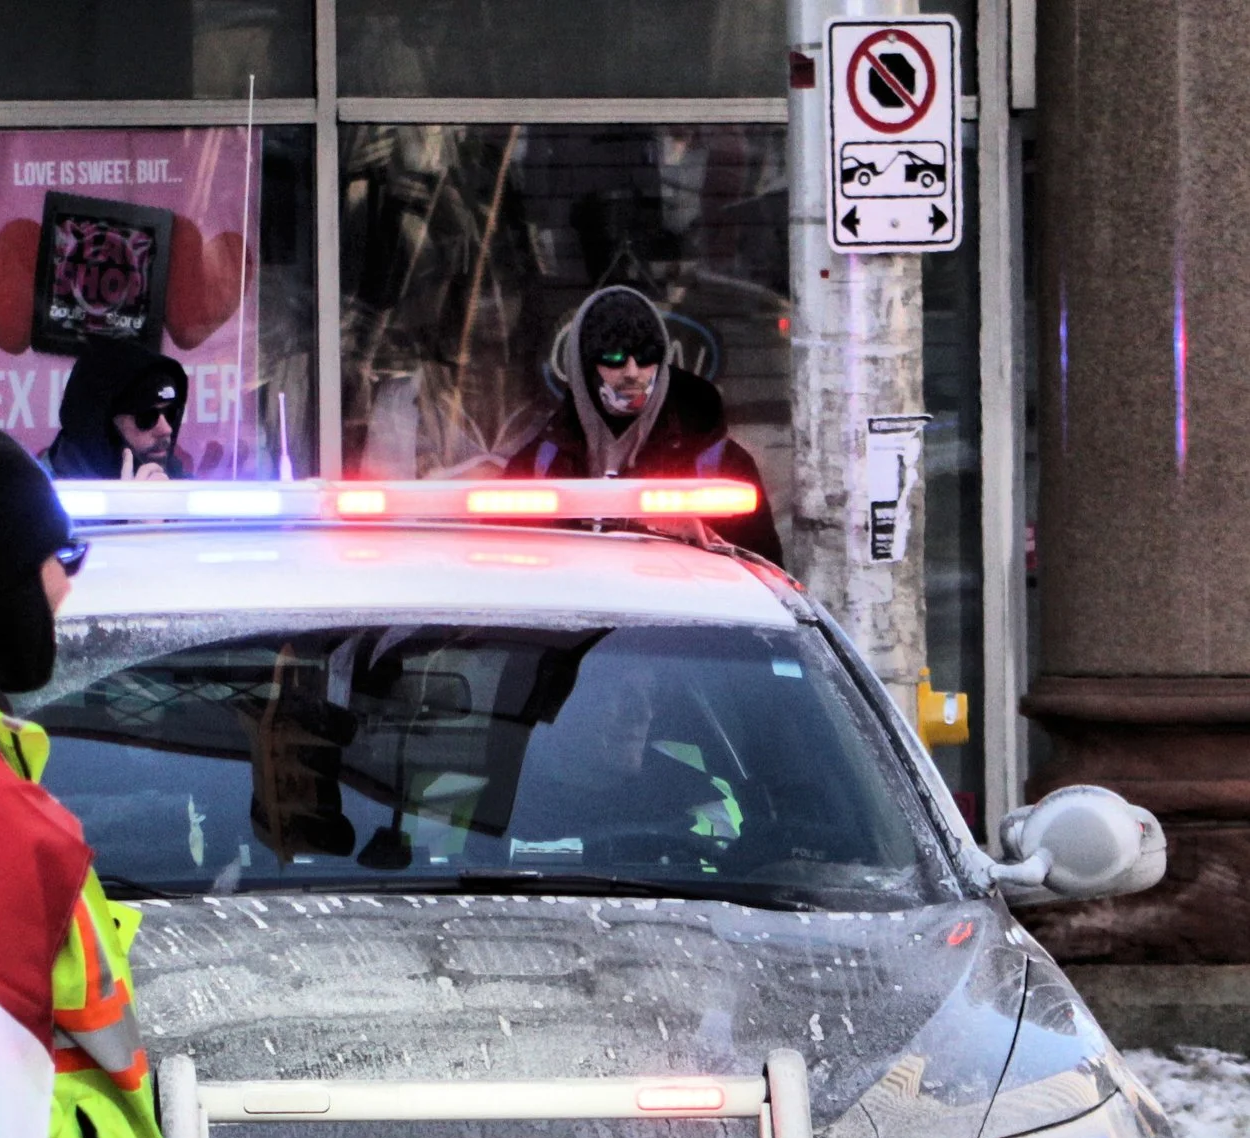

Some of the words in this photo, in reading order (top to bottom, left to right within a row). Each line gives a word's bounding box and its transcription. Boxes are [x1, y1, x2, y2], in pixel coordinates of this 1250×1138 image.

[13, 161, 56, 186] LOVE
[60, 161, 75, 185] IS
[77, 159, 134, 186] SWEET,
[137, 159, 183, 184] BUT...
[50, 368, 71, 428] I
